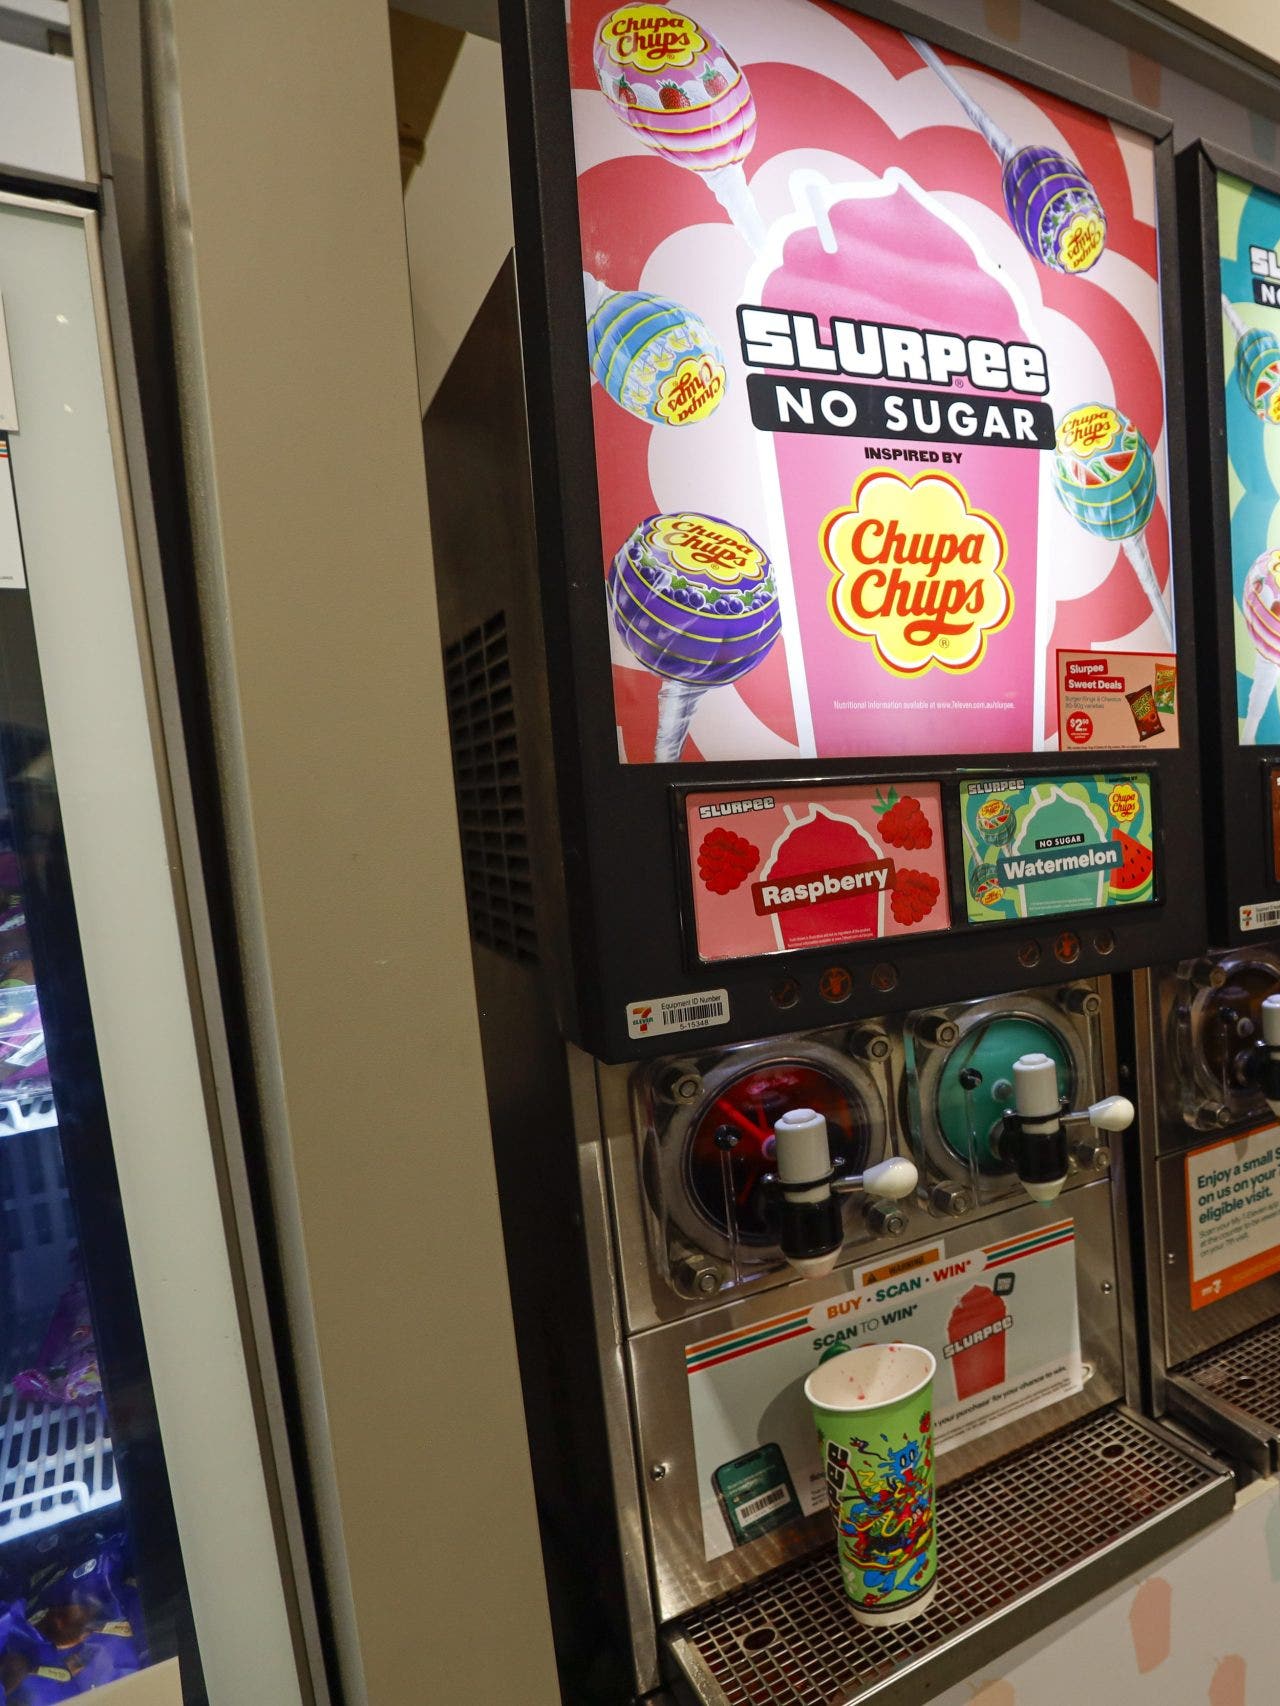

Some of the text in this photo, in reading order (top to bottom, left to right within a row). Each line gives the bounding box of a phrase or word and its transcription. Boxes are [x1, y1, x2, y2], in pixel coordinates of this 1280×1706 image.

[612, 17, 684, 36] Chupa
[617, 33, 690, 59] Chups
[667, 362, 713, 412] Chups
[678, 376, 721, 422] Chupa
[775, 385, 1039, 442] NO SUGAR
[1063, 412, 1108, 433] Chupa
[1065, 421, 1110, 446] Chups
[864, 447, 962, 464] INSPIRED BY
[663, 532, 747, 569] Chups
[672, 521, 753, 555] Chupa
[851, 518, 984, 577] Chupa
[850, 568, 984, 646] Chups
[1068, 679, 1122, 689] Sweet Deals
[1069, 663, 1104, 675] Slurpee
[833, 700, 867, 709] Nutritional
[1112, 793, 1136, 804] Chupa
[1039, 835, 1082, 848] NO SUGAR
[1003, 848, 1118, 880] Watermelon
[762, 868, 888, 907] Raspberry
[661, 995, 721, 1011] Equipment ID Number
[1197, 1167, 1231, 1189] Enjoy
[1243, 1151, 1273, 1173] small
[1197, 1190, 1215, 1207] on
[1216, 1185, 1232, 1201] us
[1233, 1179, 1249, 1193] on
[1250, 1168, 1276, 1192] your
[1199, 1186, 1273, 1224] eligible visit.
[827, 1298, 862, 1319] BUY
[875, 1277, 922, 1302] SCAN
[813, 1328, 858, 1351] SCAN
[860, 1318, 879, 1337] TO
[1003, 1387, 1018, 1400] your
